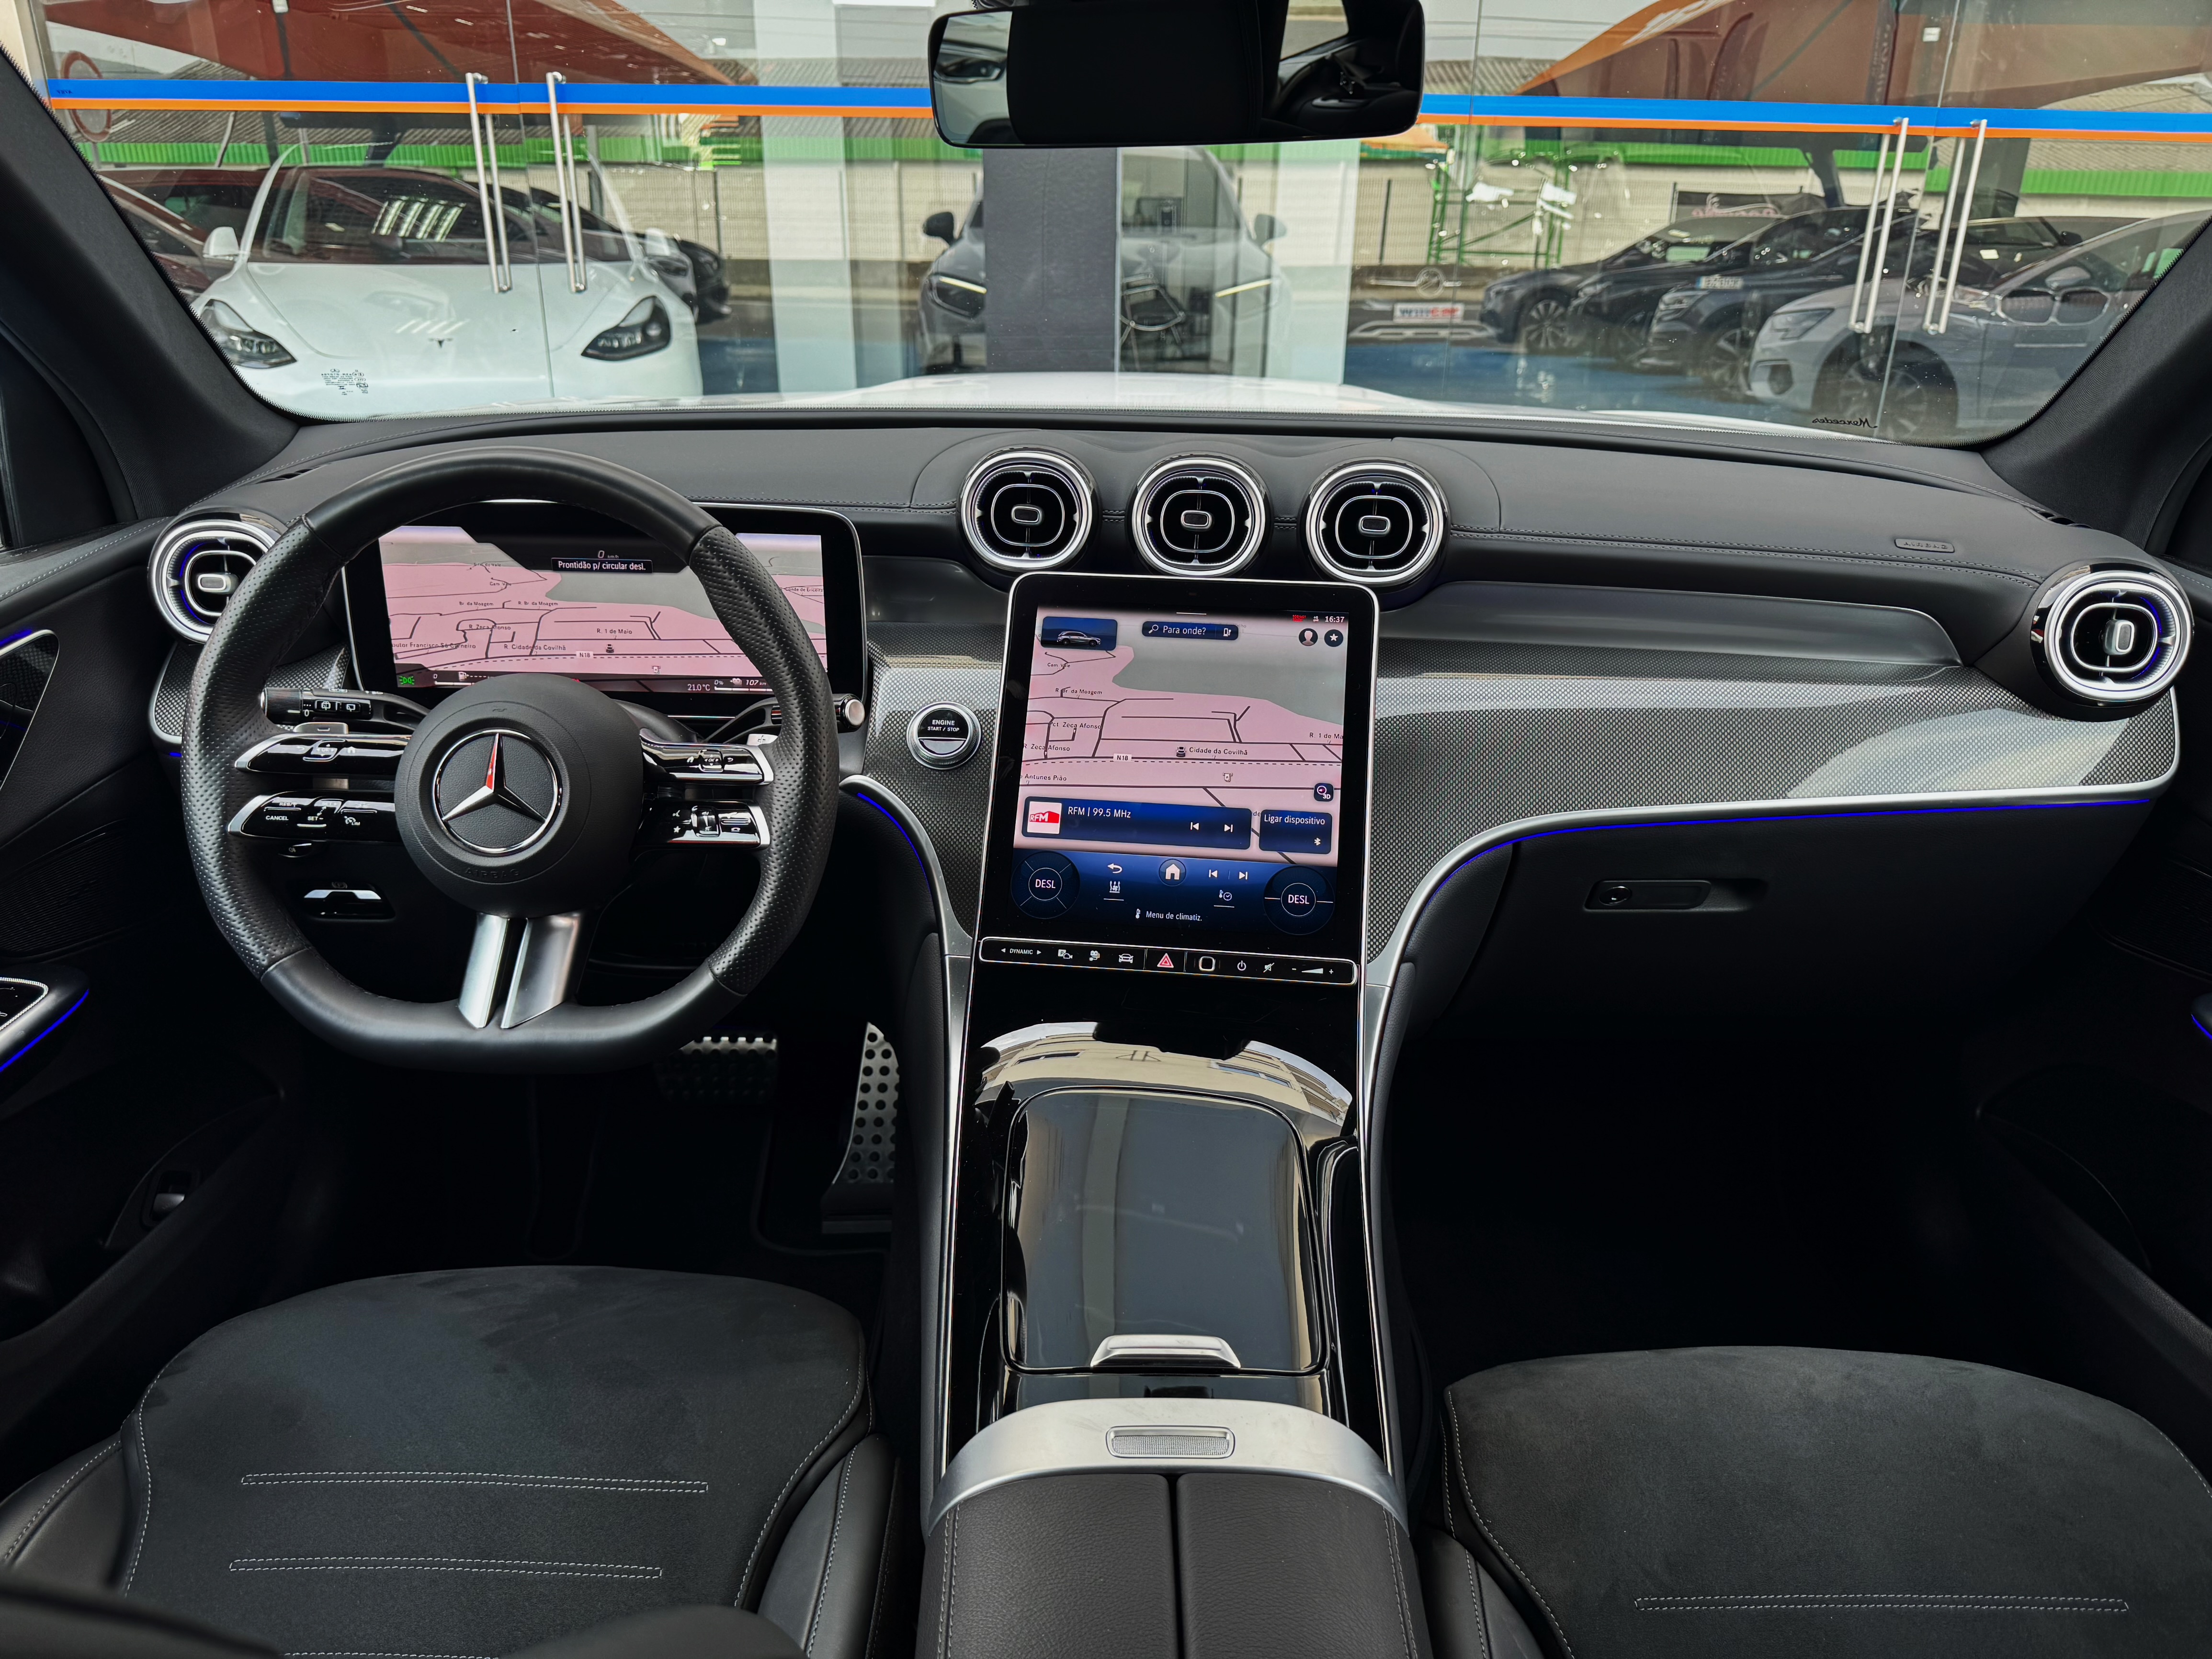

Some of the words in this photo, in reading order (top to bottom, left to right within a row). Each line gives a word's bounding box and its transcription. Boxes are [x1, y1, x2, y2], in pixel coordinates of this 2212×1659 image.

[598, 550, 604, 558] 0
[558, 561, 591, 569] Prontidão
[592, 562, 601, 570] p/
[602, 562, 627, 570] circular
[629, 562, 646, 570] desl.
[1163, 625, 1180, 634] Para
[1182, 627, 1206, 635] onde?
[1068, 807, 1085, 816] RFM
[1093, 808, 1111, 817] 99.5
[1113, 809, 1131, 818] MHz
[1030, 813, 1049, 822] RFM
[1264, 814, 1282, 824] Ligar
[1284, 816, 1325, 825] dispositivo
[1035, 879, 1056, 888] DESL
[1288, 894, 1309, 904] DESL
[1176, 913, 1202, 921] climatiz.
